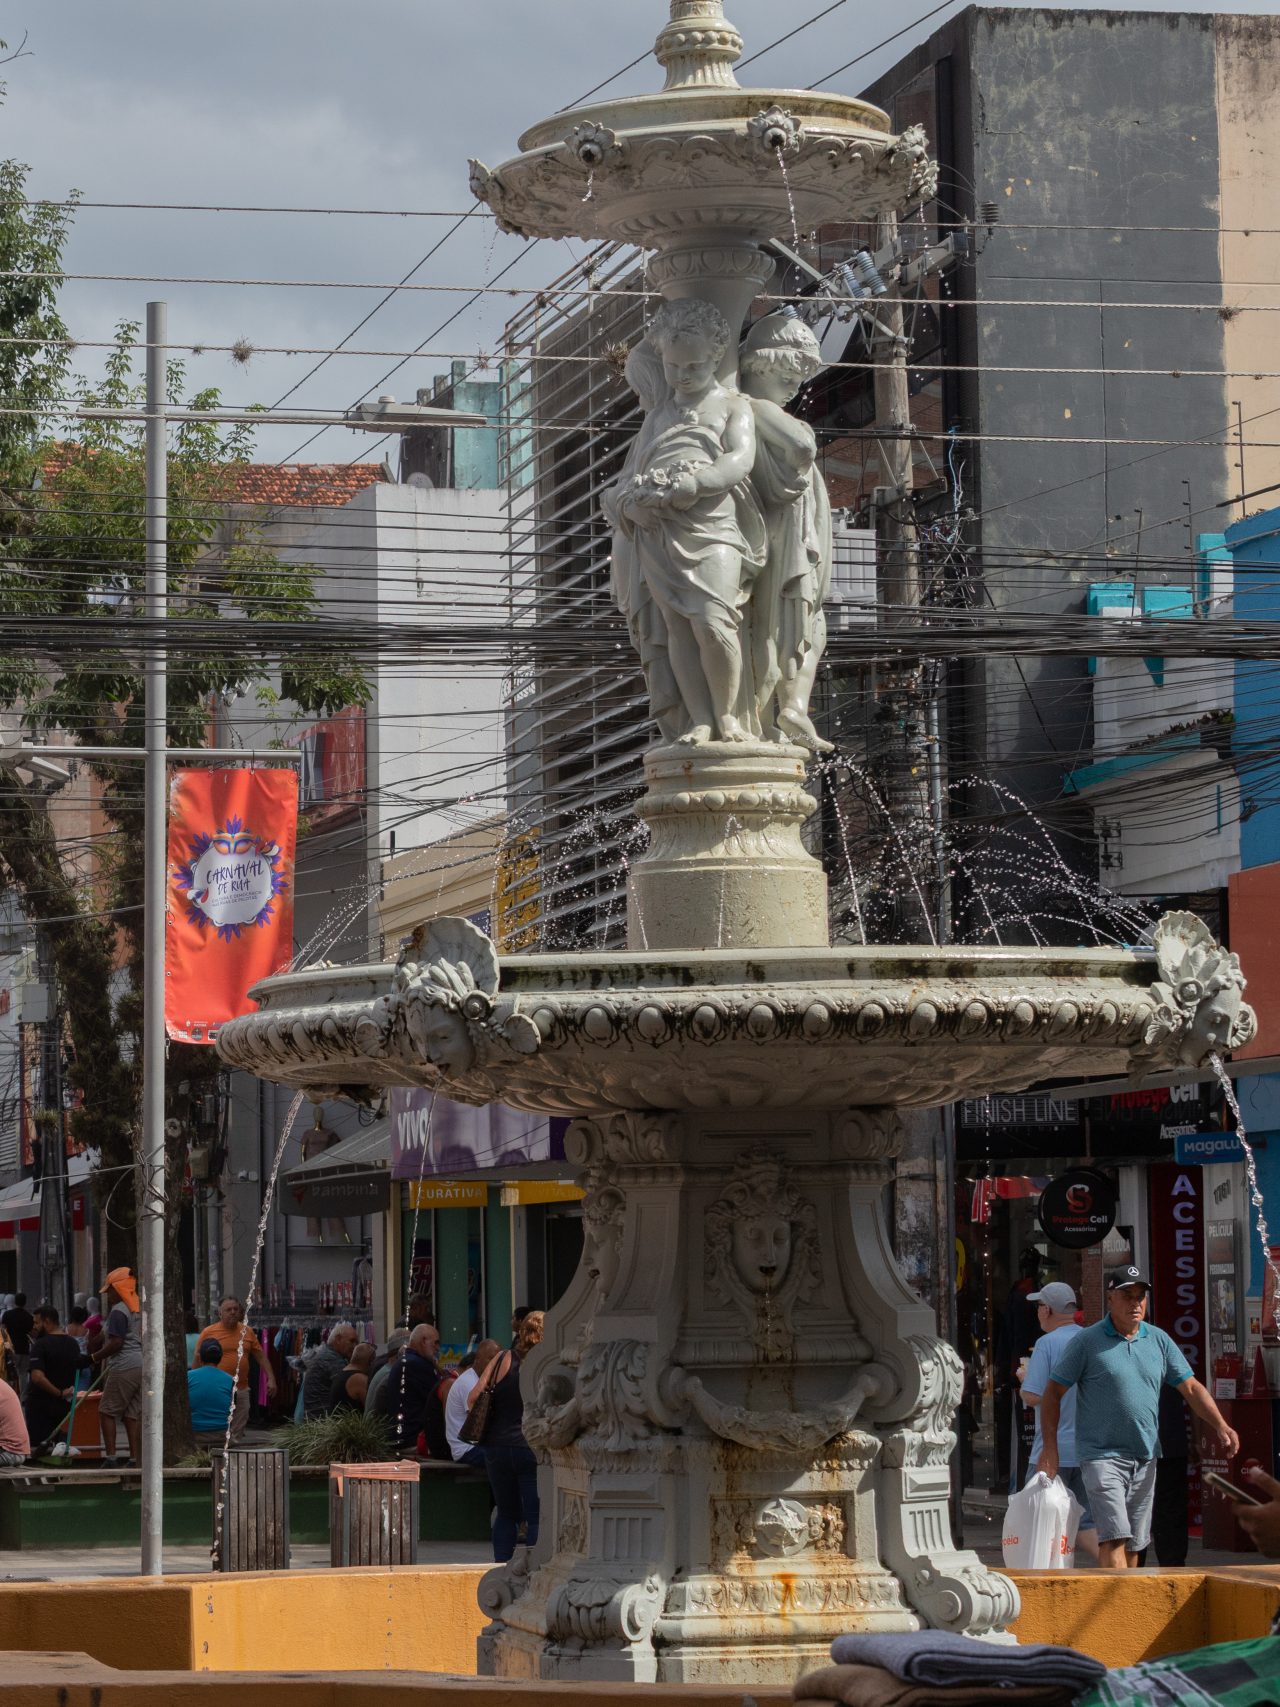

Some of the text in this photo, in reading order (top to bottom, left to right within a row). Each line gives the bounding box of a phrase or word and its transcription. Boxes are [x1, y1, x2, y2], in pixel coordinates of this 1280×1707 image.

[206, 860, 264, 884] CARNAVAL
[218, 879, 251, 895] DE RUA
[964, 1098, 1076, 1123] FINISH LINE
[1184, 1139, 1239, 1155] Magalu
[312, 1182, 378, 1197] bambina
